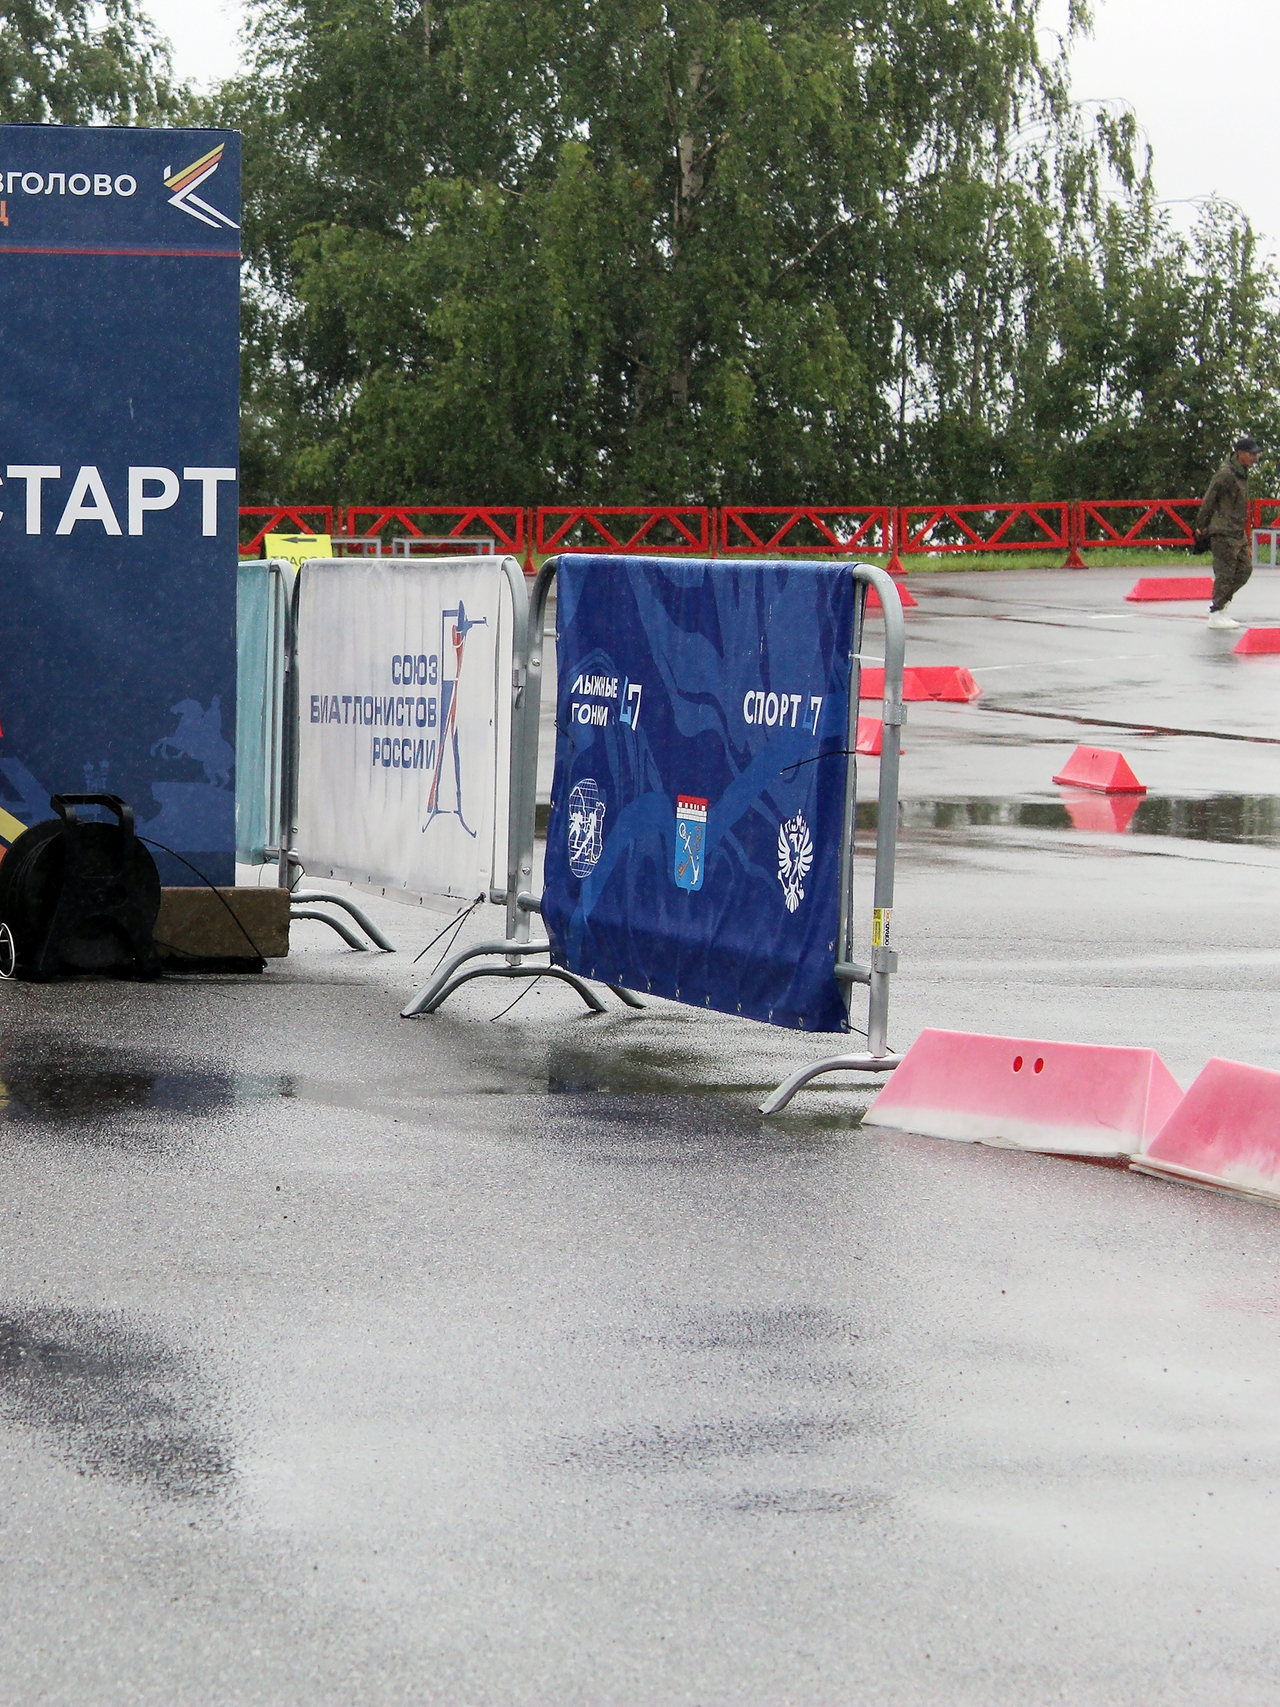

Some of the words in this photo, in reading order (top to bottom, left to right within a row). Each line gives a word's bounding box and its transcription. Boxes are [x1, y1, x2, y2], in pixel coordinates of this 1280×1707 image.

[392, 654, 438, 685] СОЮЗ
[571, 674, 619, 698] ЛЫЖНЫЕ
[310, 694, 437, 728] БИАТЛОНИСТОВ
[571, 702, 609, 727] ГОНКИ
[743, 690, 802, 728] СПОРТ
[373, 737, 436, 770] РОССИИ
